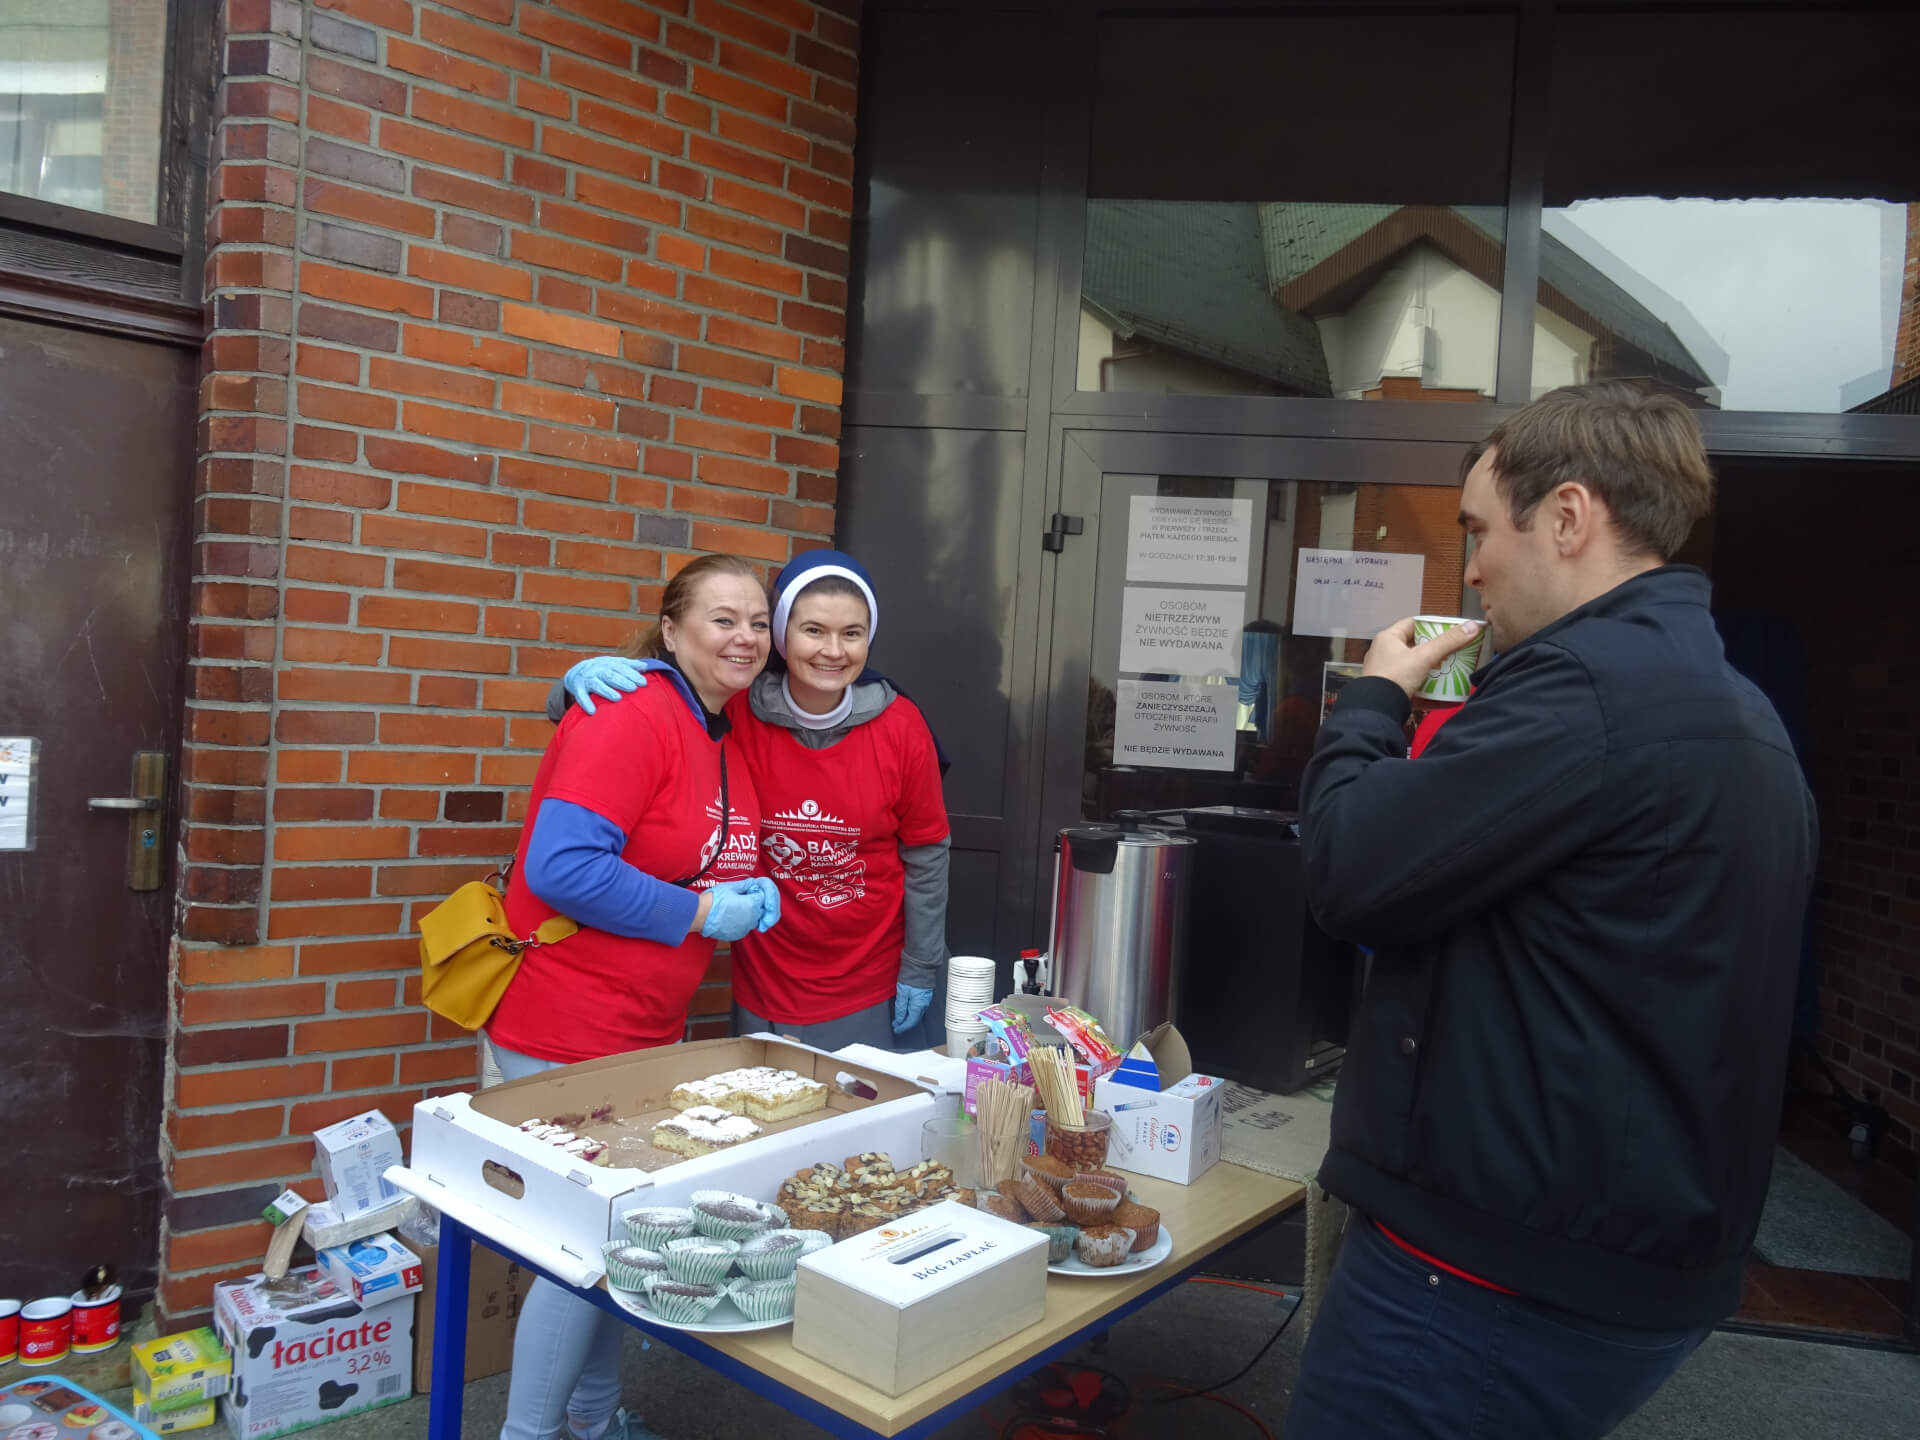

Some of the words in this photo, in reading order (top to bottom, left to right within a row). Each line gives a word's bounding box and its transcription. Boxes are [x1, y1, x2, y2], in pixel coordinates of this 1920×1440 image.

[1148, 552, 1194, 561] GODZINACH
[1160, 600, 1208, 612] OSOBOM
[1144, 612, 1222, 625] NIETRZEŹWYM
[1135, 623, 1188, 636] ŻYWNOŚĆ
[1190, 627, 1229, 639] BĘDZIE
[1139, 638, 1157, 648] NIE
[1159, 639, 1224, 650] WYDAWANA
[1135, 702, 1217, 714] ZANIECZYSZCZAJĄ
[1134, 712, 1183, 723] OTOCZENIE
[1184, 714, 1218, 724] PARAFII
[1123, 745, 1138, 753] NIE
[1140, 745, 1171, 755] BĘDZIE
[1172, 747, 1225, 759] WYDAWANA
[912, 1264, 948, 1281] BÓG
[946, 1240, 998, 1267] ZAPŁAĆ
[271, 1320, 393, 1370] łaciate
